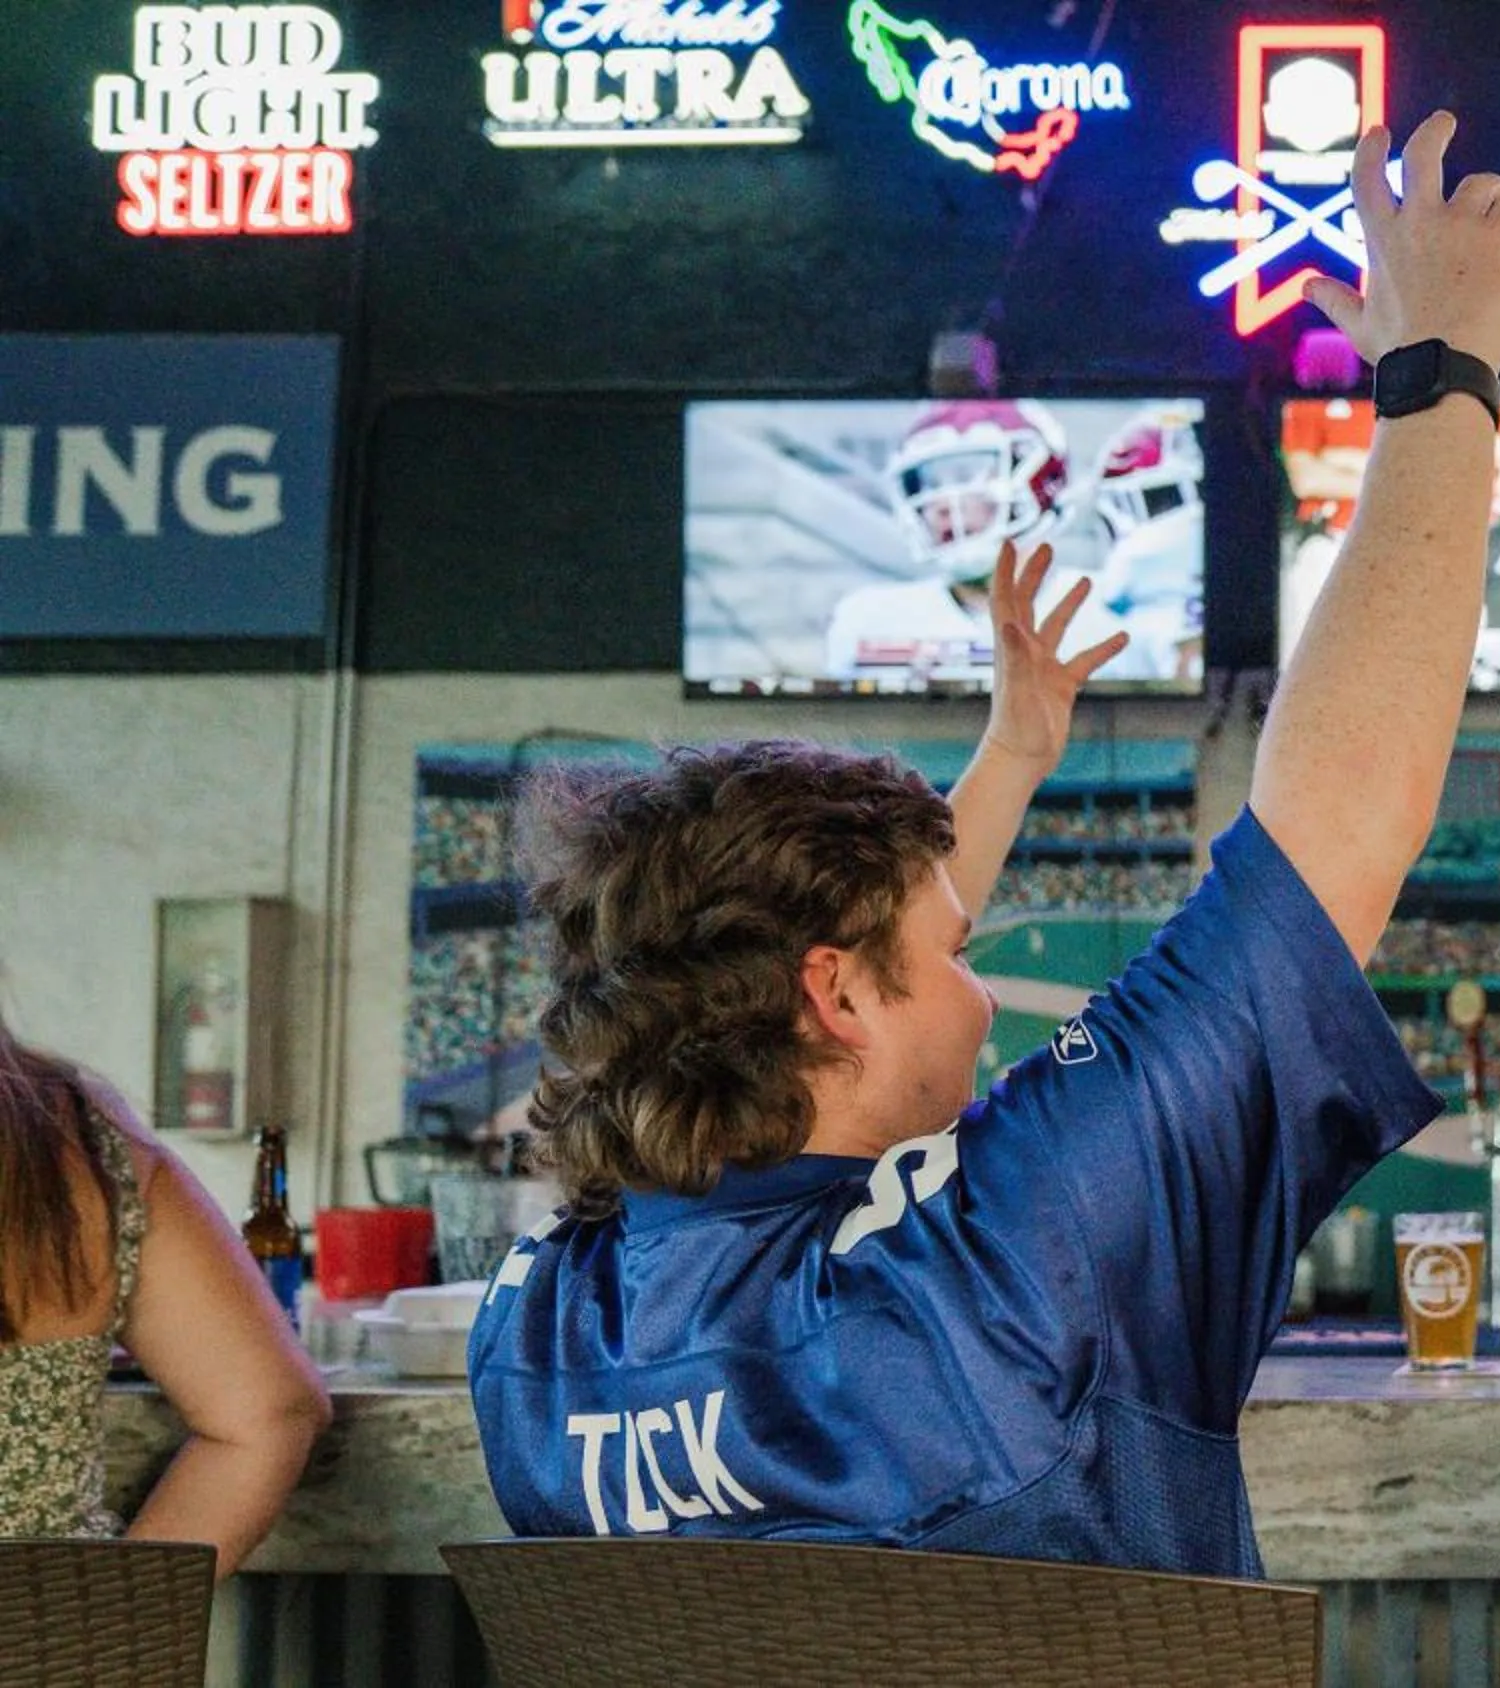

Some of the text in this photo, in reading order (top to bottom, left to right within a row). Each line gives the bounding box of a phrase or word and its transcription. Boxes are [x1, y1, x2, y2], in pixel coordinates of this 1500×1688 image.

[133, 5, 343, 78] BUD
[92, 73, 380, 151] LIGHT
[480, 46, 811, 123] ULTRA
[918, 54, 1131, 127] Corona
[117, 149, 353, 237] SELTZER
[0, 424, 286, 537] ING
